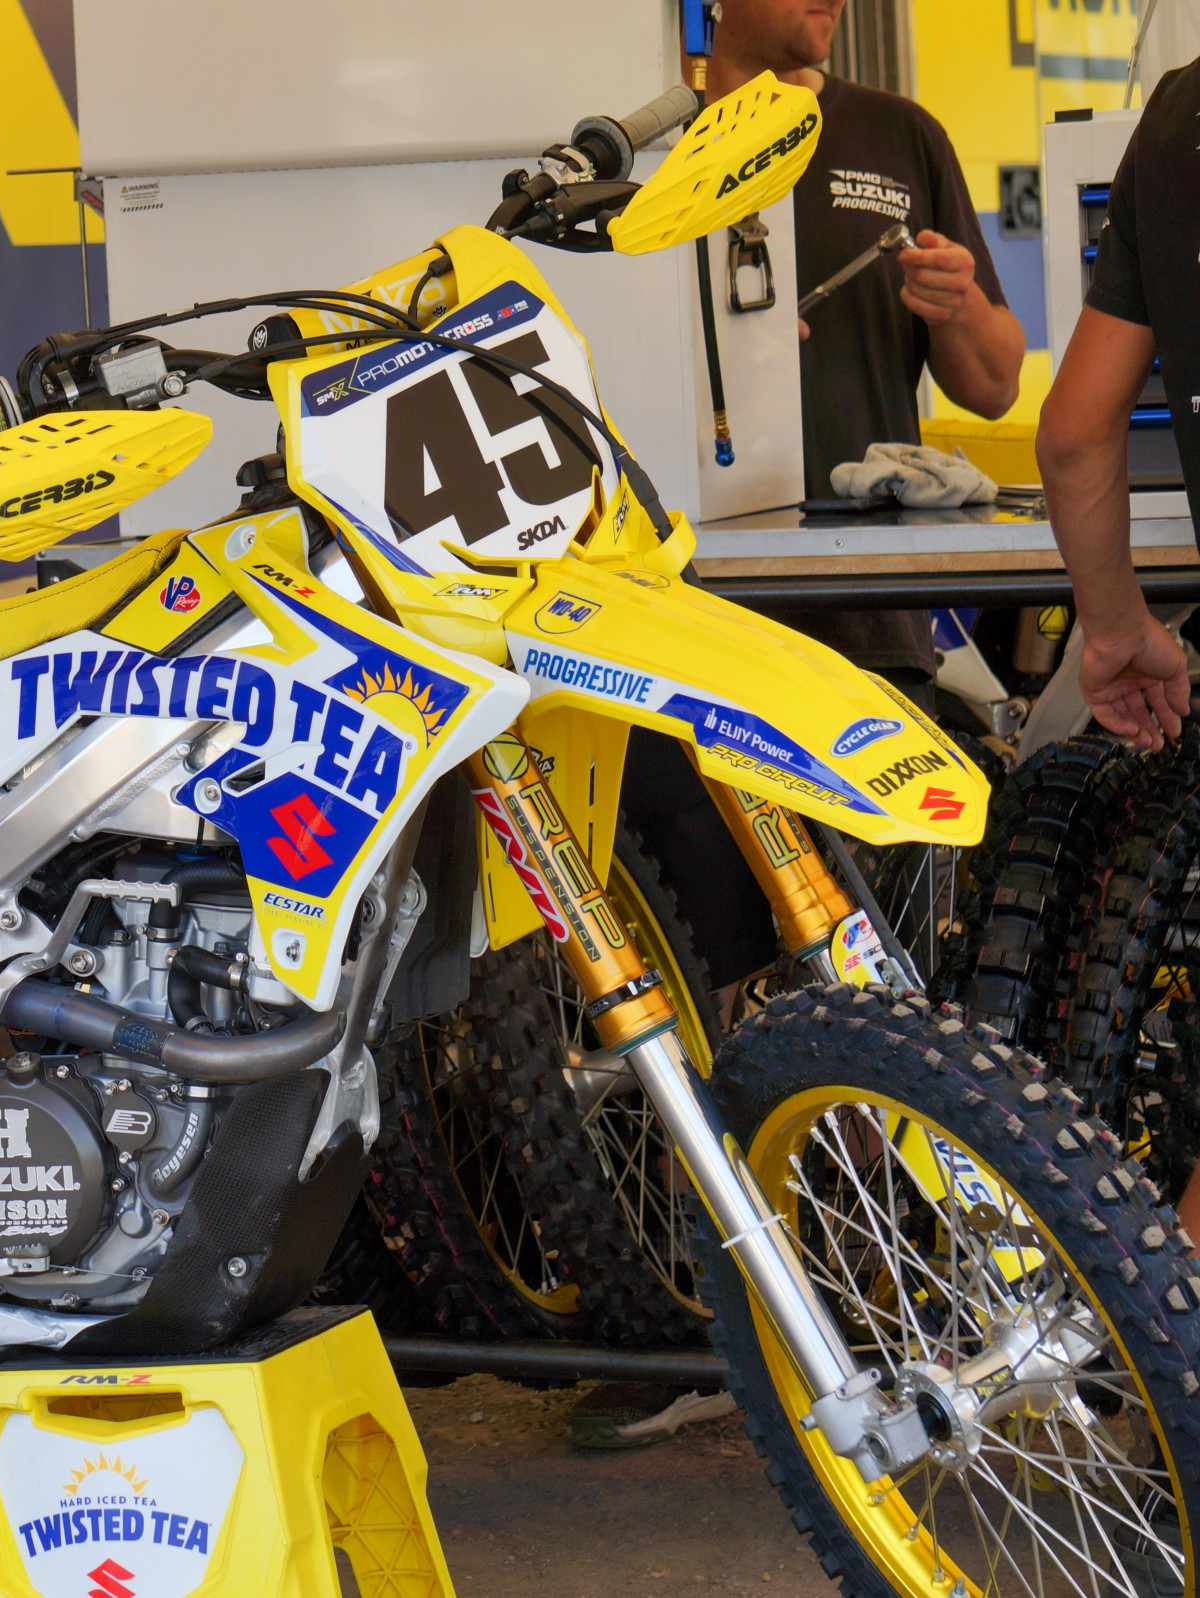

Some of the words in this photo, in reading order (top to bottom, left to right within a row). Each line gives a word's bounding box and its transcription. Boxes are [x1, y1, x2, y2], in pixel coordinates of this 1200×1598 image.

[830, 181, 911, 209] SUZUKI
[832, 196, 908, 222] PROGRESSIVE
[384, 330, 603, 546] 45
[517, 515, 567, 551] SKDA
[164, 575, 195, 610] VP
[548, 598, 592, 623] WD-40
[523, 648, 654, 704] PROGRESSIVE
[11, 651, 276, 748] TWISTED
[290, 680, 404, 814] TEA
[750, 733, 794, 763] Power
[836, 727, 870, 753] CYCLE
[868, 722, 897, 732] GEAR
[707, 743, 760, 769] PRO
[755, 763, 852, 806] CIRCUIT
[866, 750, 950, 797] DIXXON
[506, 796, 599, 961] SUSPENSION
[519, 783, 628, 950] REP
[263, 891, 328, 921] ECSTAR
[59, 1375, 152, 1385] RM-Z
[60, 1497, 91, 1508] HARD
[97, 1495, 127, 1505] ICED
[133, 1496, 157, 1507] TEA
[19, 1508, 145, 1558] TWISTED
[151, 1512, 210, 1556] TEA
